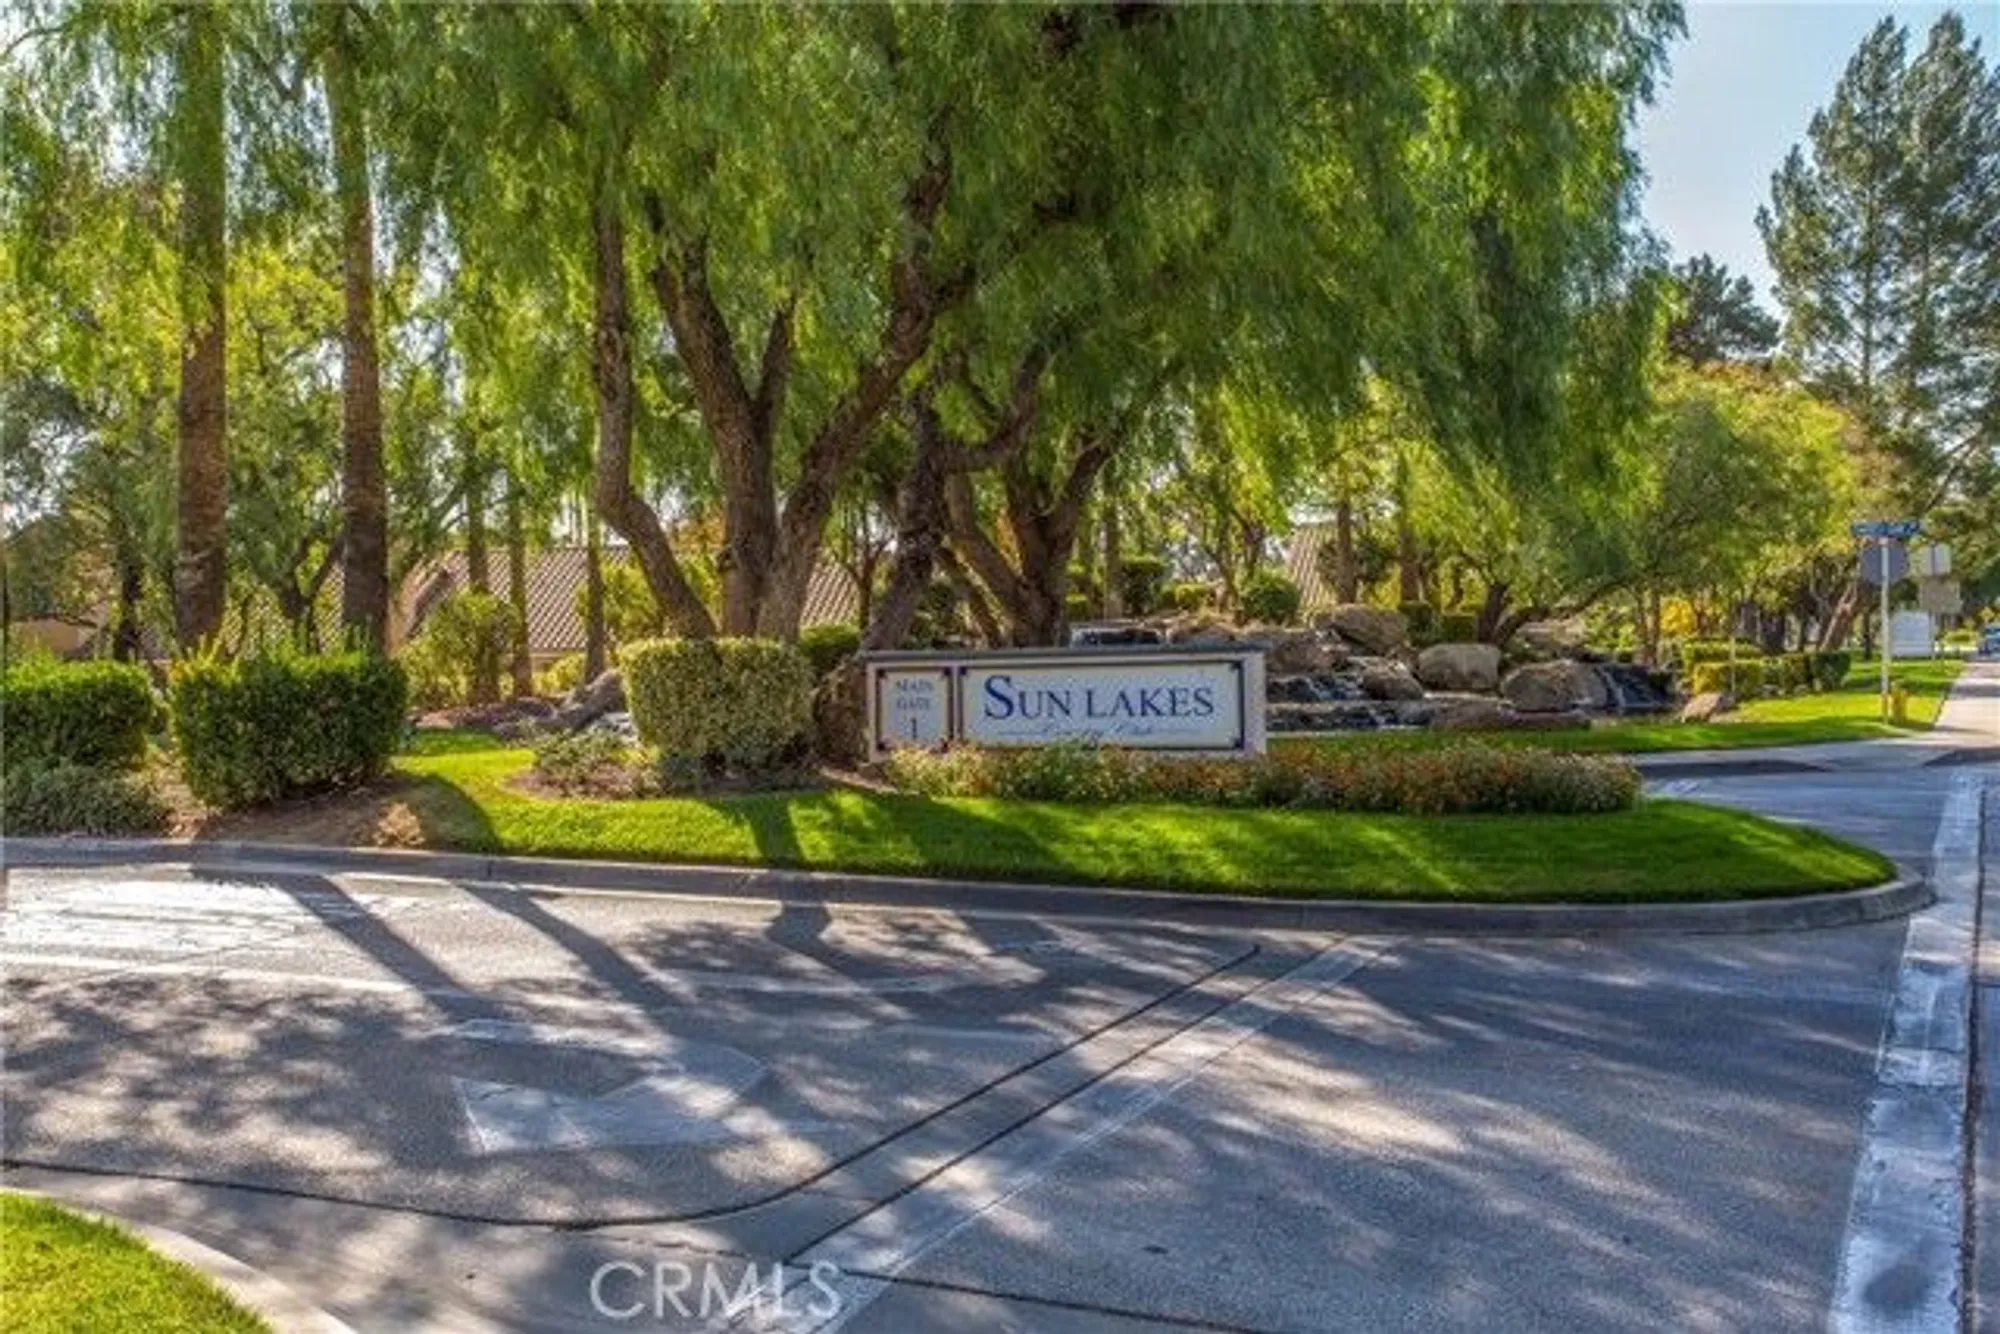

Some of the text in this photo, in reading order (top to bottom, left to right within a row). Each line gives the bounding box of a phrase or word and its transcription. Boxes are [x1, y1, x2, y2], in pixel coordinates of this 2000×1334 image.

[895, 679, 934, 693] MAIN
[983, 674, 1215, 720] SUN LAKES
[909, 717, 919, 739] 1
